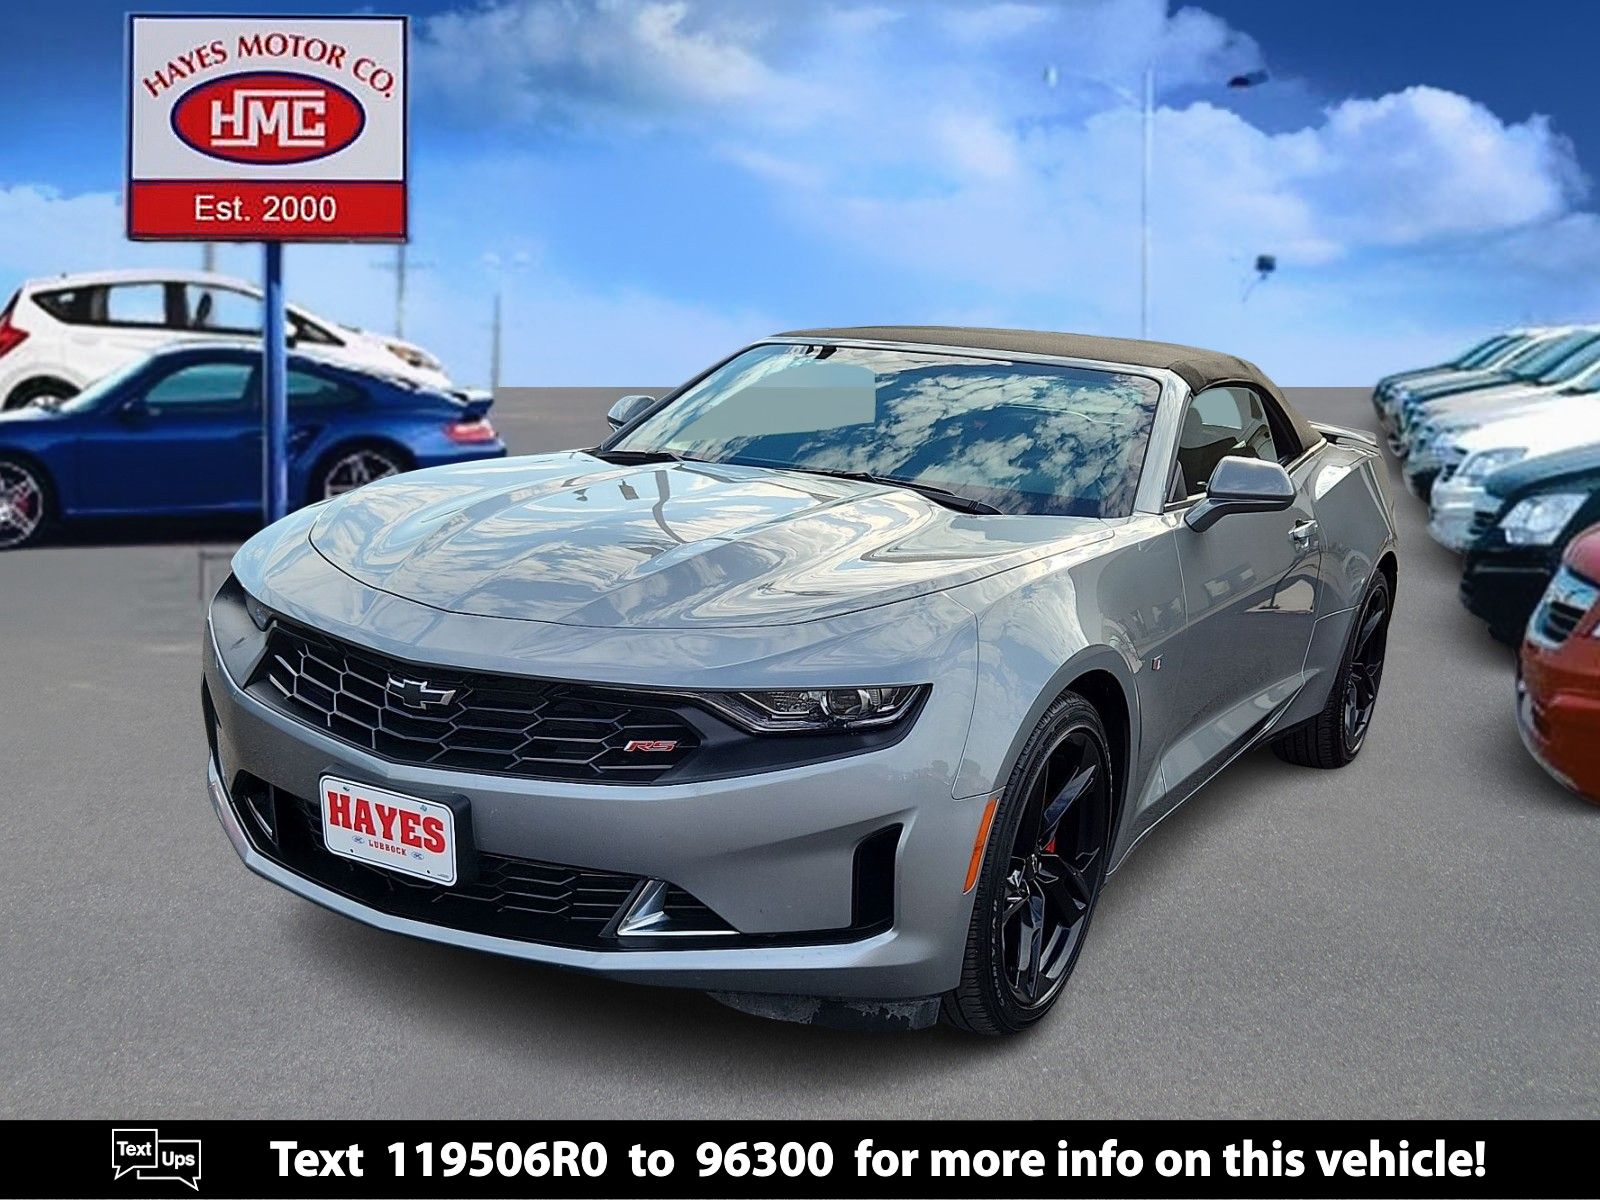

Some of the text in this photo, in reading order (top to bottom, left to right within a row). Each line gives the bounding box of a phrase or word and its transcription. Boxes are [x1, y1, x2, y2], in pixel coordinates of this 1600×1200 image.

[142, 32, 395, 98] HAYES MOTOR CO.
[210, 89, 326, 147] HMC
[195, 195, 337, 222] Est. 2000
[623, 740, 677, 752] RS
[327, 791, 446, 854] HAYES
[368, 839, 408, 856] LUBBOCK
